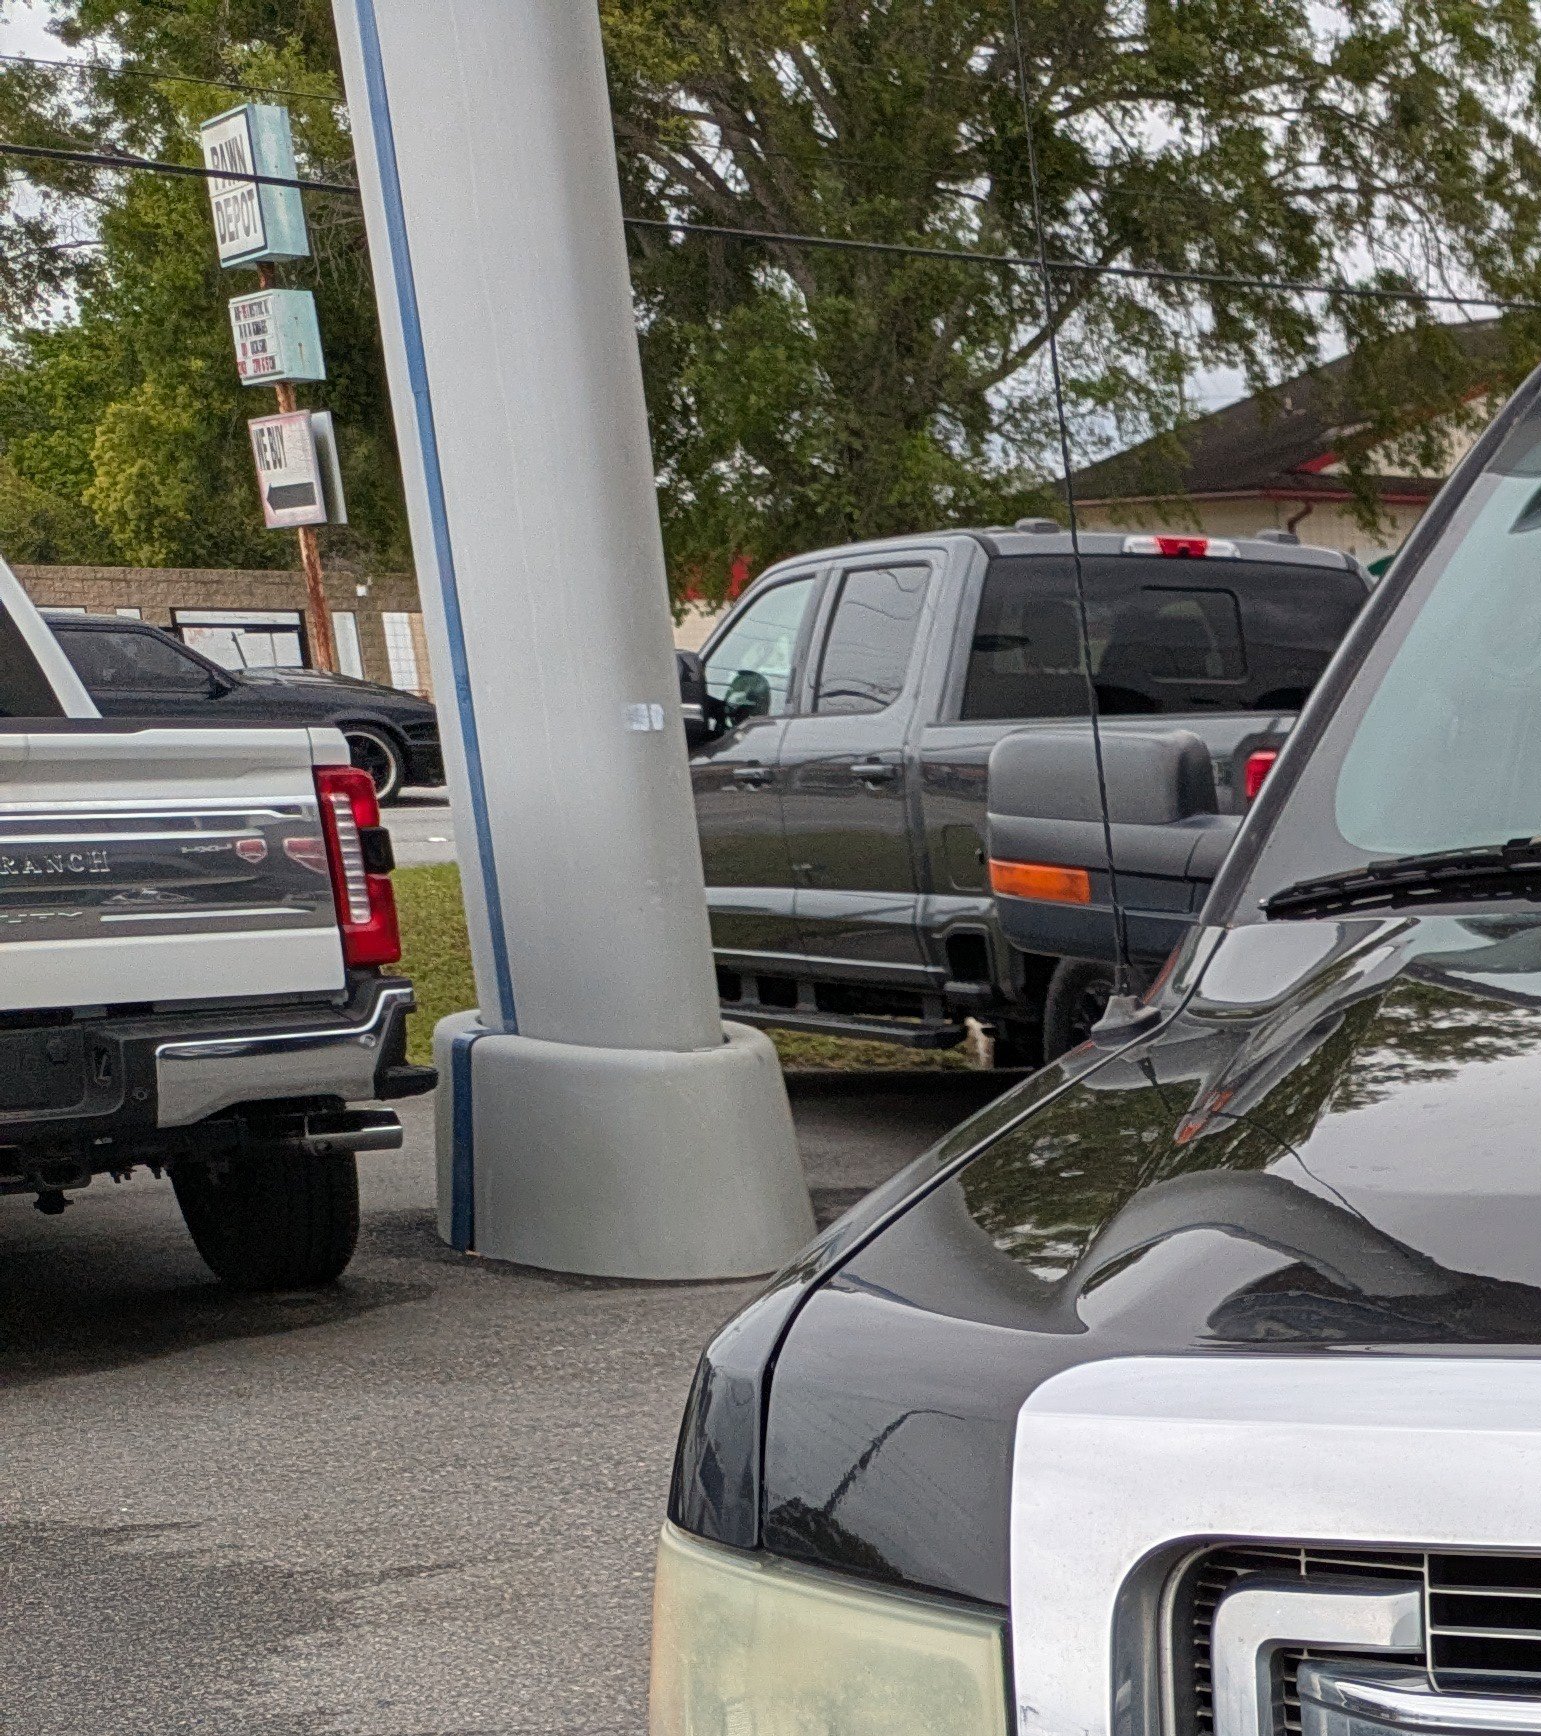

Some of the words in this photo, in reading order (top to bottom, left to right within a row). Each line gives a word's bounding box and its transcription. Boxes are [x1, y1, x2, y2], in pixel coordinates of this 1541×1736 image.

[210, 134, 248, 190] PAWN
[214, 188, 257, 245] DEPOT
[252, 427, 271, 471] WE
[266, 425, 287, 470] BUY
[0, 850, 111, 875] RANCH
